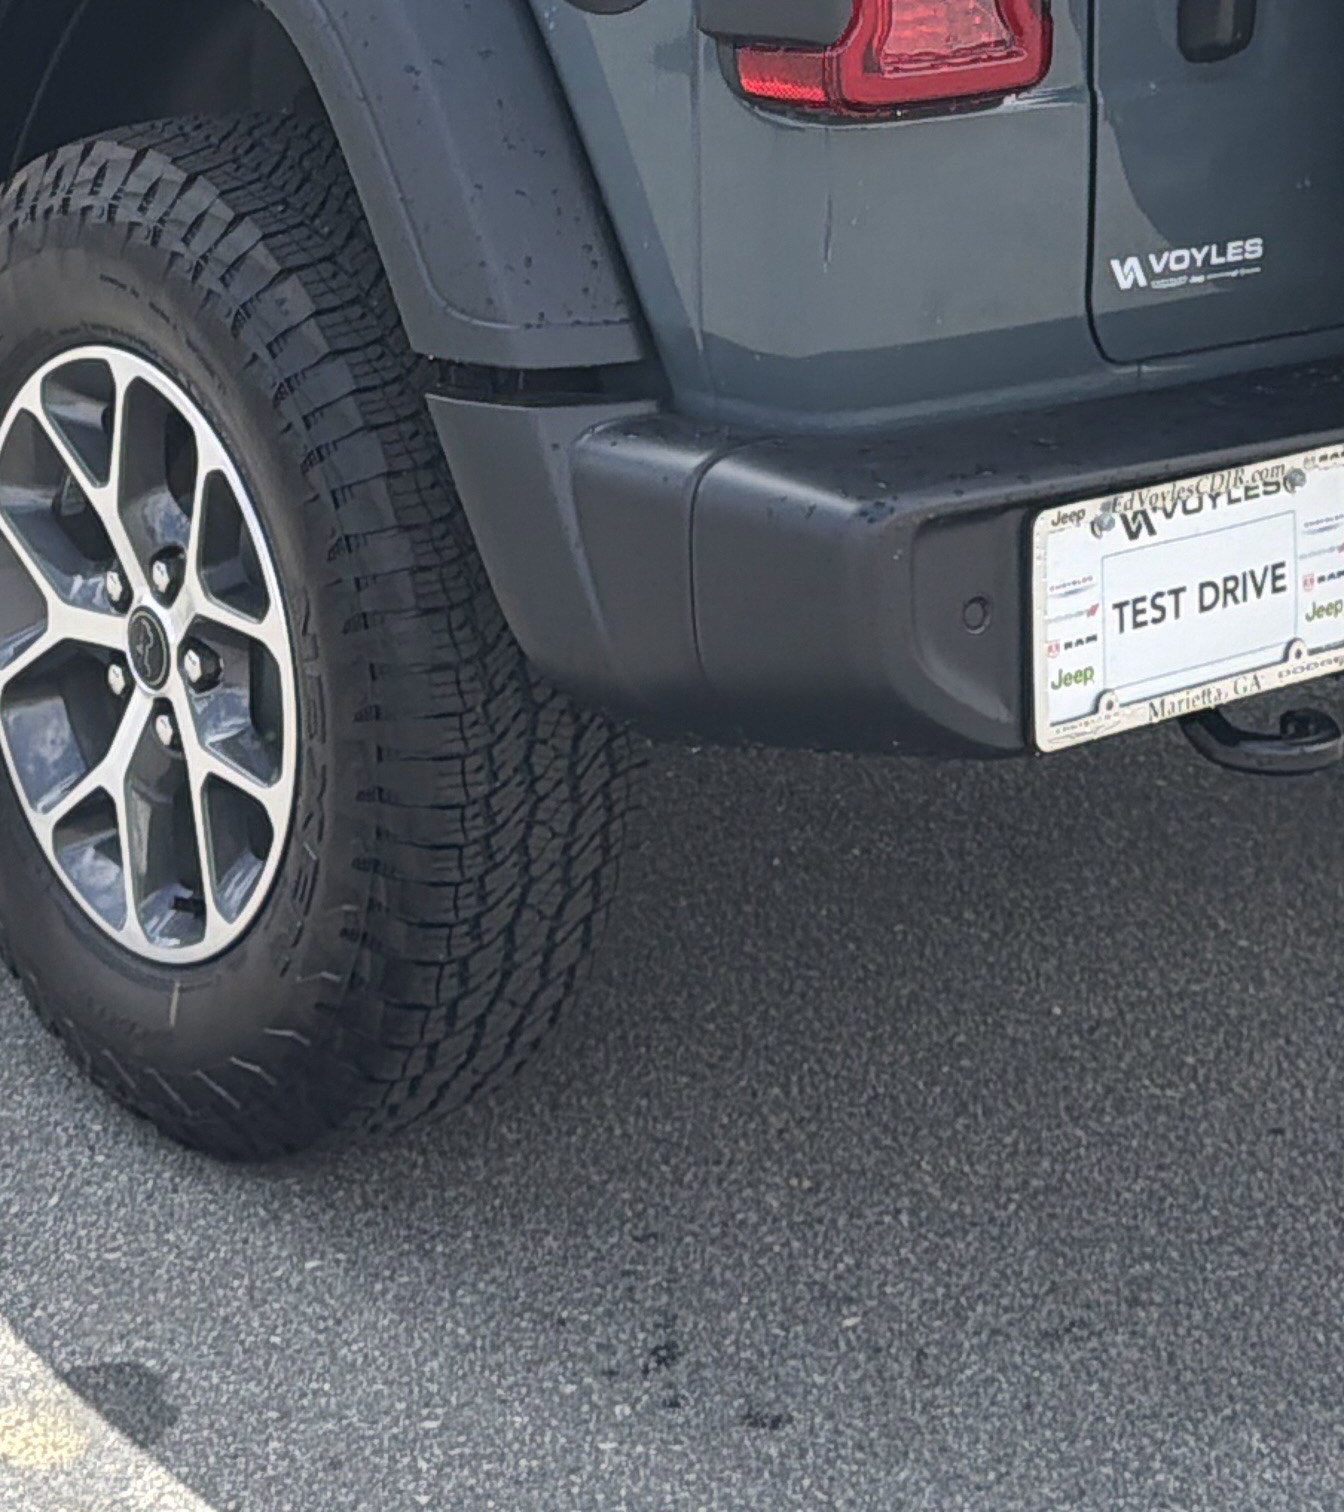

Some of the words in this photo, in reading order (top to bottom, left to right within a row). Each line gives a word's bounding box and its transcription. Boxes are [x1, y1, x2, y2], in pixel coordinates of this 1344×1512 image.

[1148, 238, 1263, 274] VOYLES
[1051, 506, 1087, 527] Jeep
[1112, 586, 1187, 634] TEST
[1197, 561, 1288, 614] DRIVE
[1304, 598, 1344, 623] Jeep
[1051, 665, 1096, 691] Jeep
[1232, 673, 1263, 696] GA
